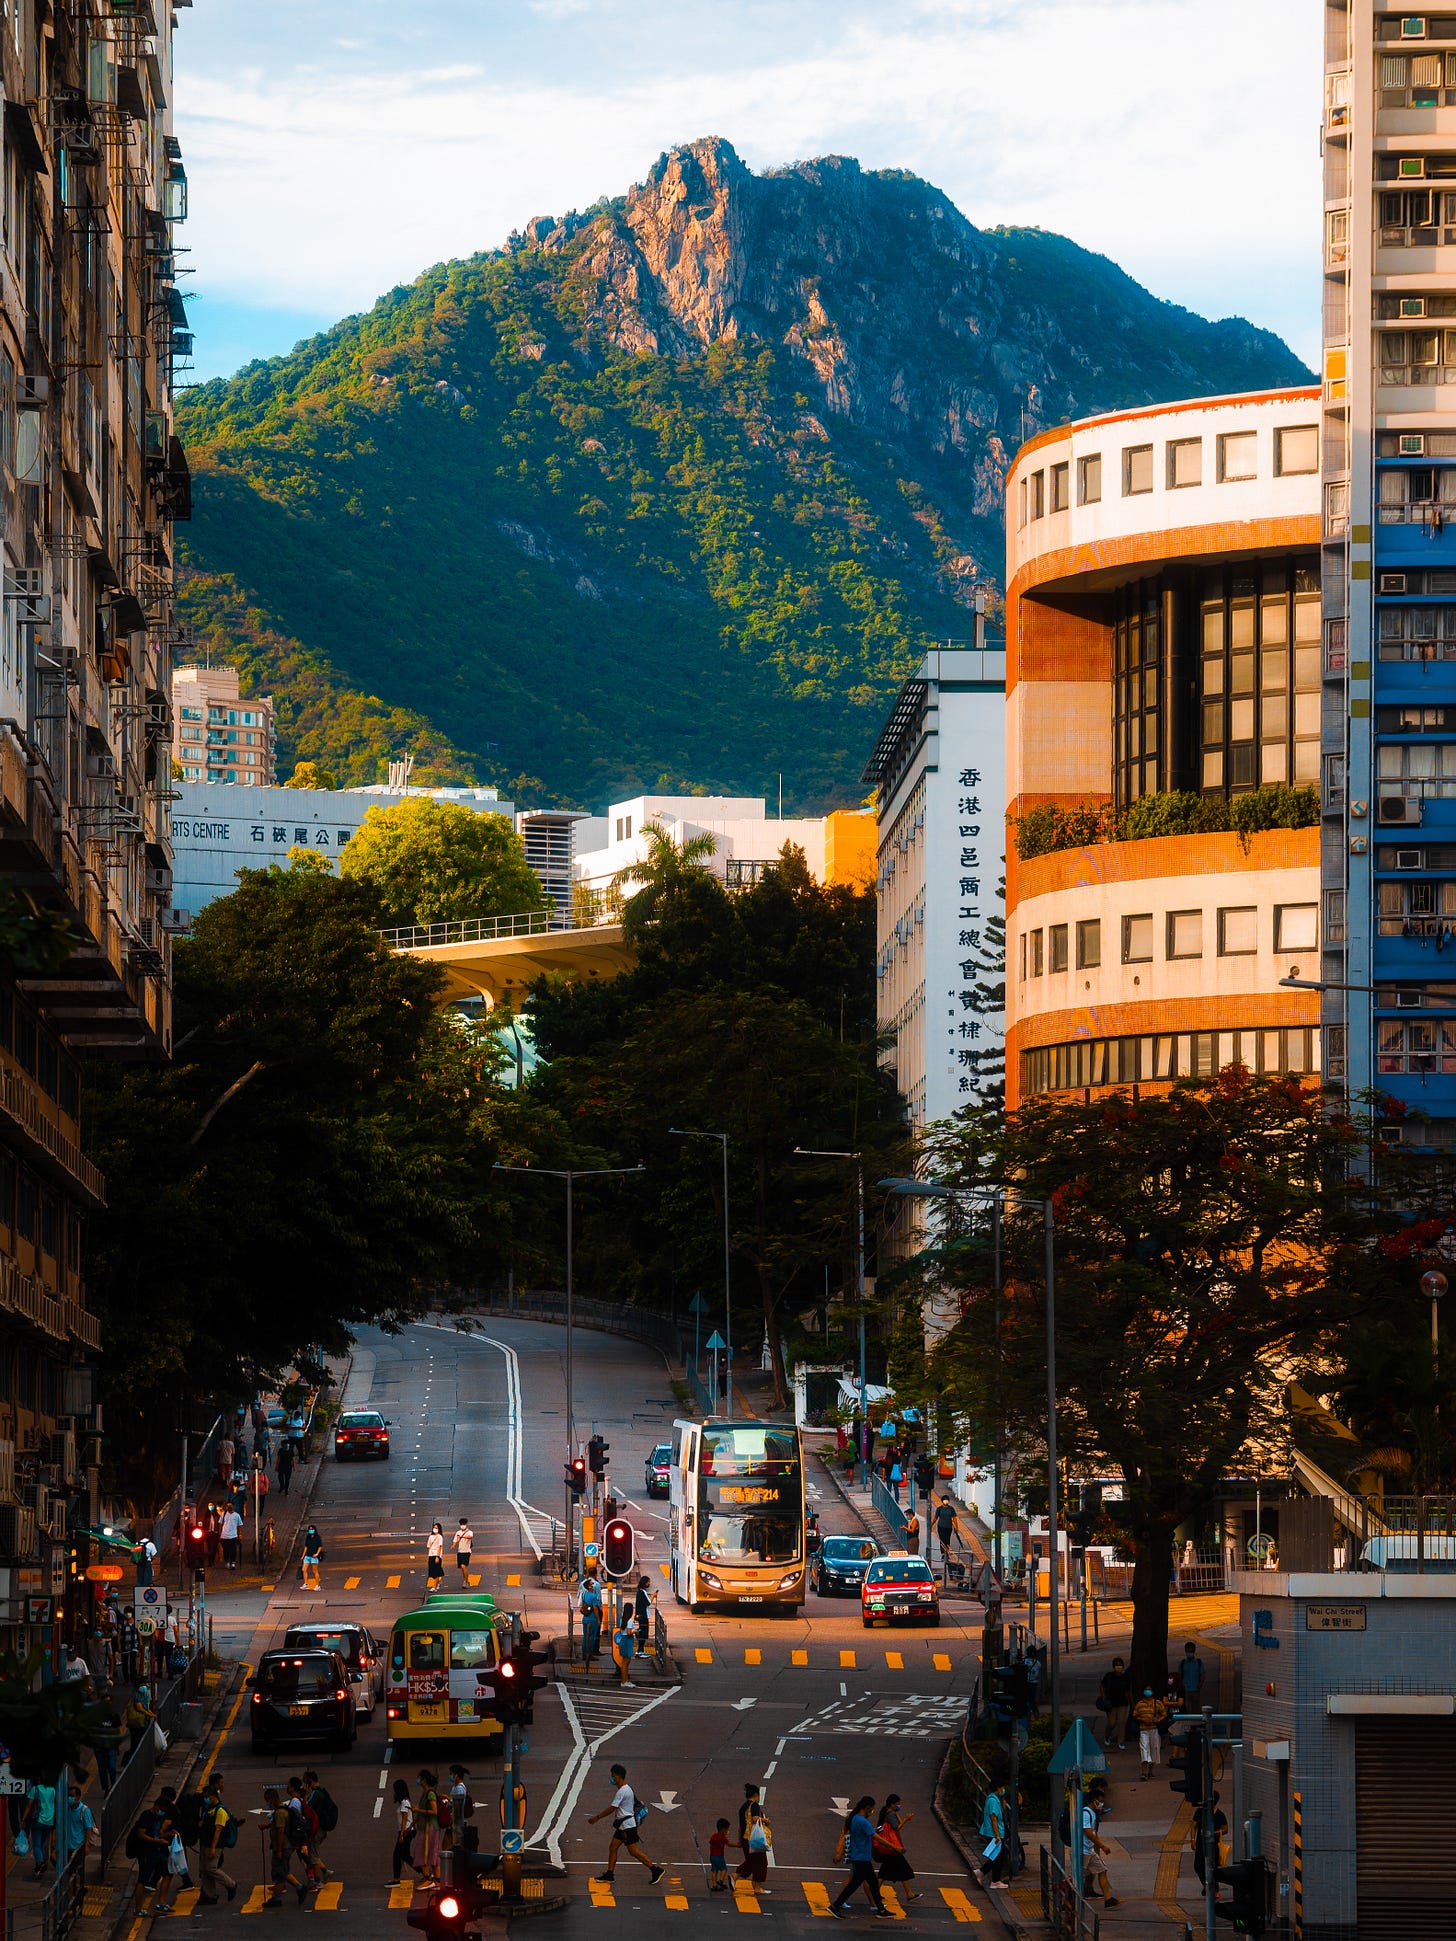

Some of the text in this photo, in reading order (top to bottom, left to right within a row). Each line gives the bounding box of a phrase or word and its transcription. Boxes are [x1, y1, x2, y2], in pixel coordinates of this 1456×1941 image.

[193, 822, 230, 840] CENTRE
[250, 825, 351, 846] 石硤尾公園
[762, 1488, 779, 1501] 214
[1309, 1607, 1363, 1615] Wai Chi Street
[139, 1621, 153, 1633] 30A
[838, 1716, 959, 1728] STOP
[832, 1725, 932, 1736] BUS
[9, 1782, 23, 1793] 12
